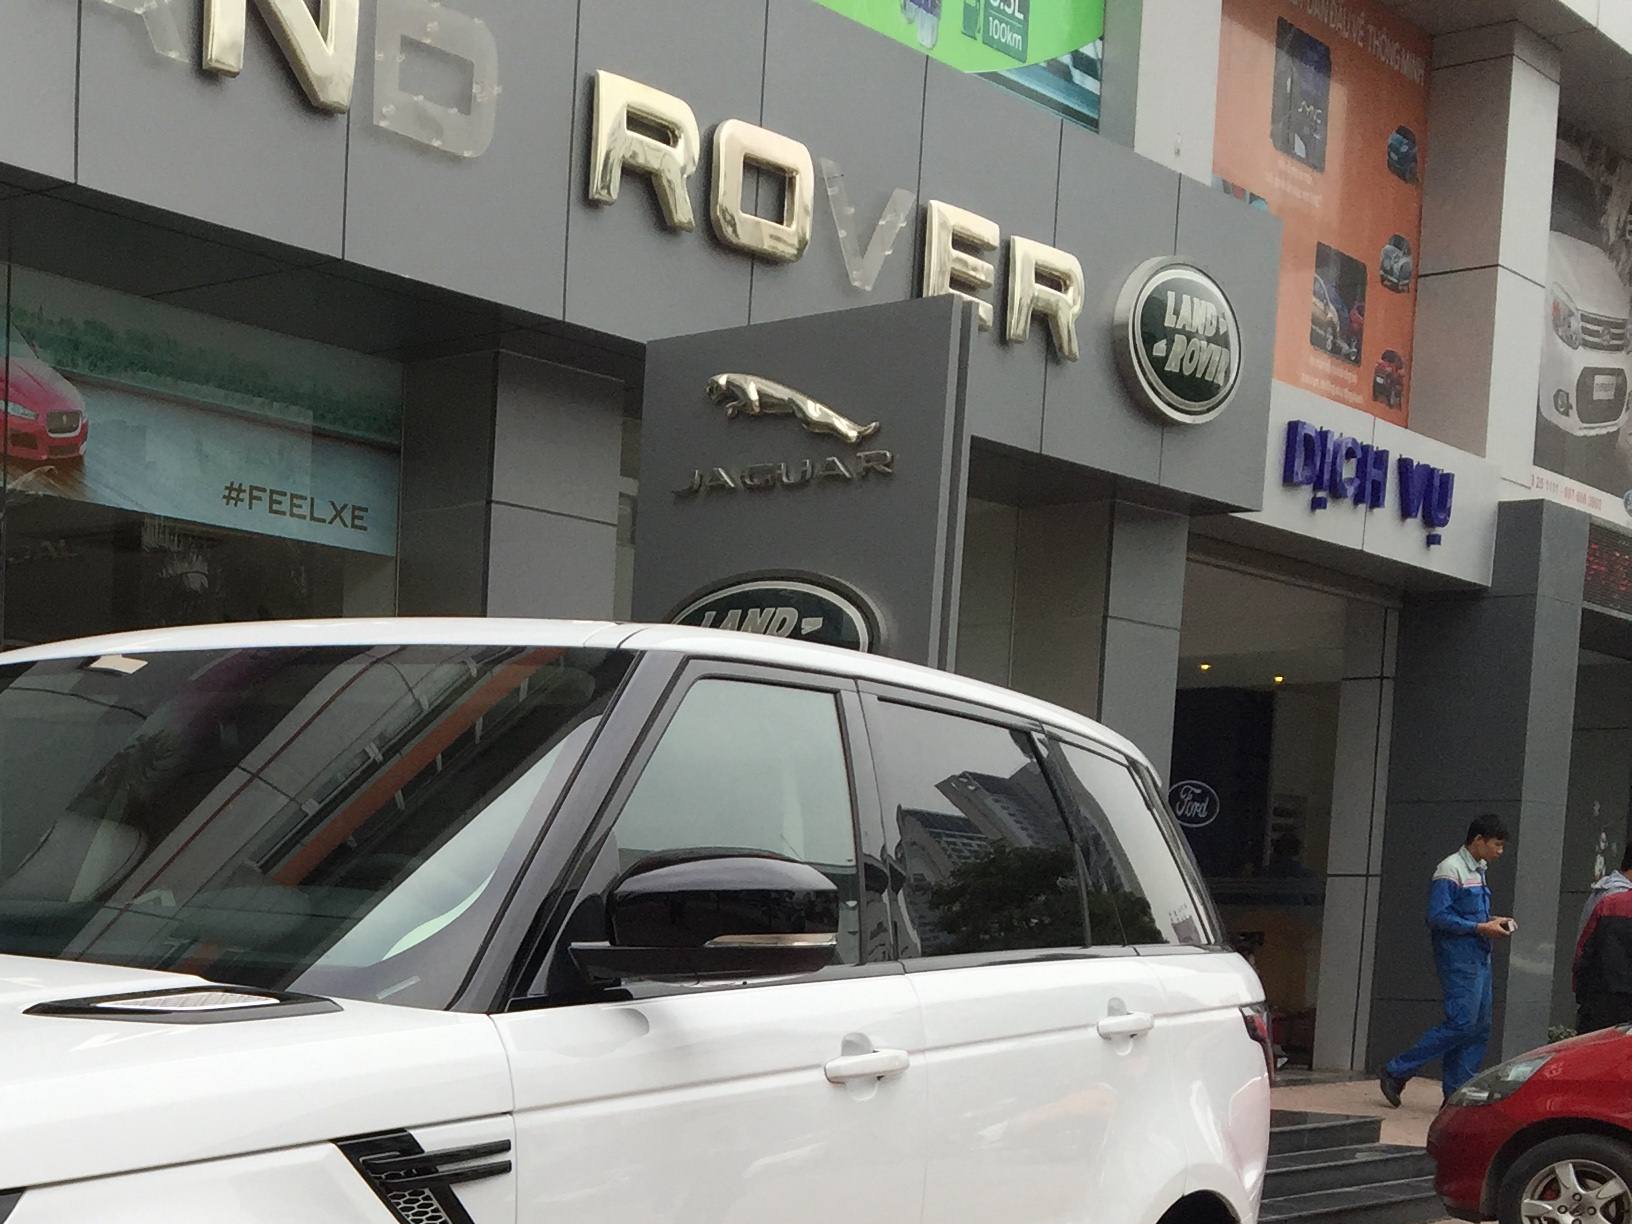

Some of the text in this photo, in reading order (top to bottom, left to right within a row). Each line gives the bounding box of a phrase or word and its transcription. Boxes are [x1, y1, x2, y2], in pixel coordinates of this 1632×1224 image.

[988, 16, 1023, 51] 100km
[588, 68, 1086, 363] ROVER
[671, 450, 894, 497] JAGUAR
[1282, 419, 1456, 547] DỊCH VỤ
[222, 480, 369, 532] #FEELXE
[1176, 785, 1209, 818] Ford
